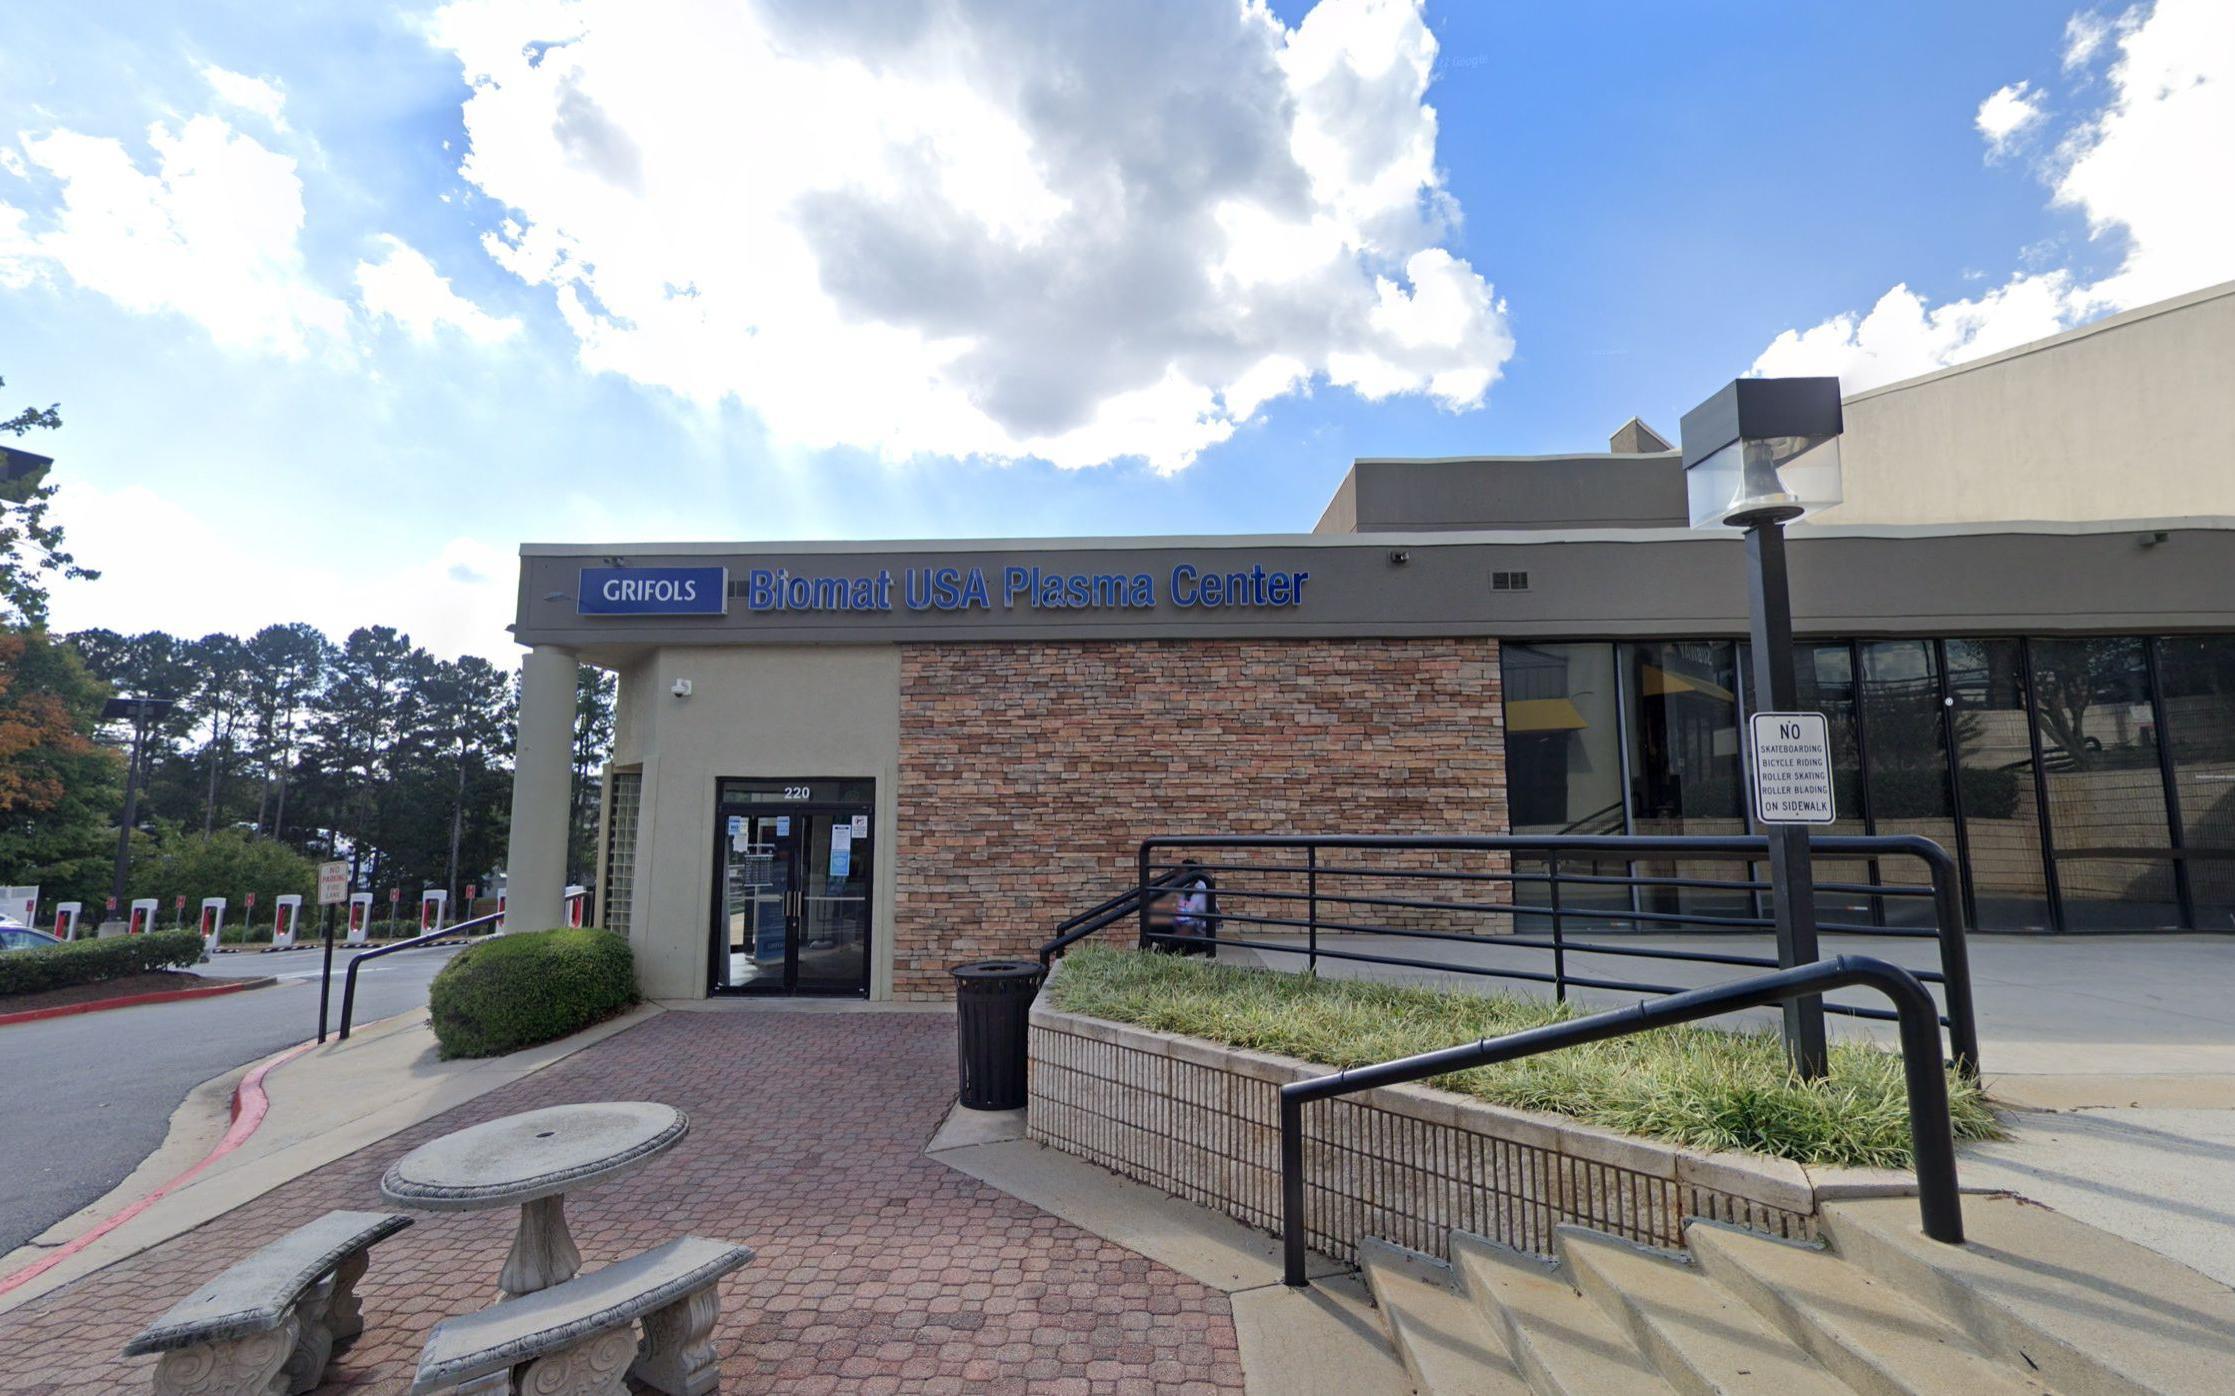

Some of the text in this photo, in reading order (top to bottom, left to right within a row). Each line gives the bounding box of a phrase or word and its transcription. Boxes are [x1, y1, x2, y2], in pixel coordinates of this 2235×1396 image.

[603, 580, 696, 601] GRIFOLS
[748, 563, 1310, 610] Biomat USA Plasma Center
[1780, 724, 1801, 740] NO
[1760, 745, 1822, 753] SKATEBOARDING
[1762, 758, 1823, 767] BICYCLE RIDING
[1762, 772, 1825, 781] ROLLER SKATING
[784, 786, 810, 799] 220
[1762, 785, 1828, 795] ROLLER BLADING
[1765, 801, 1827, 812] ON SIDEWALK
[329, 866, 340, 874] NO
